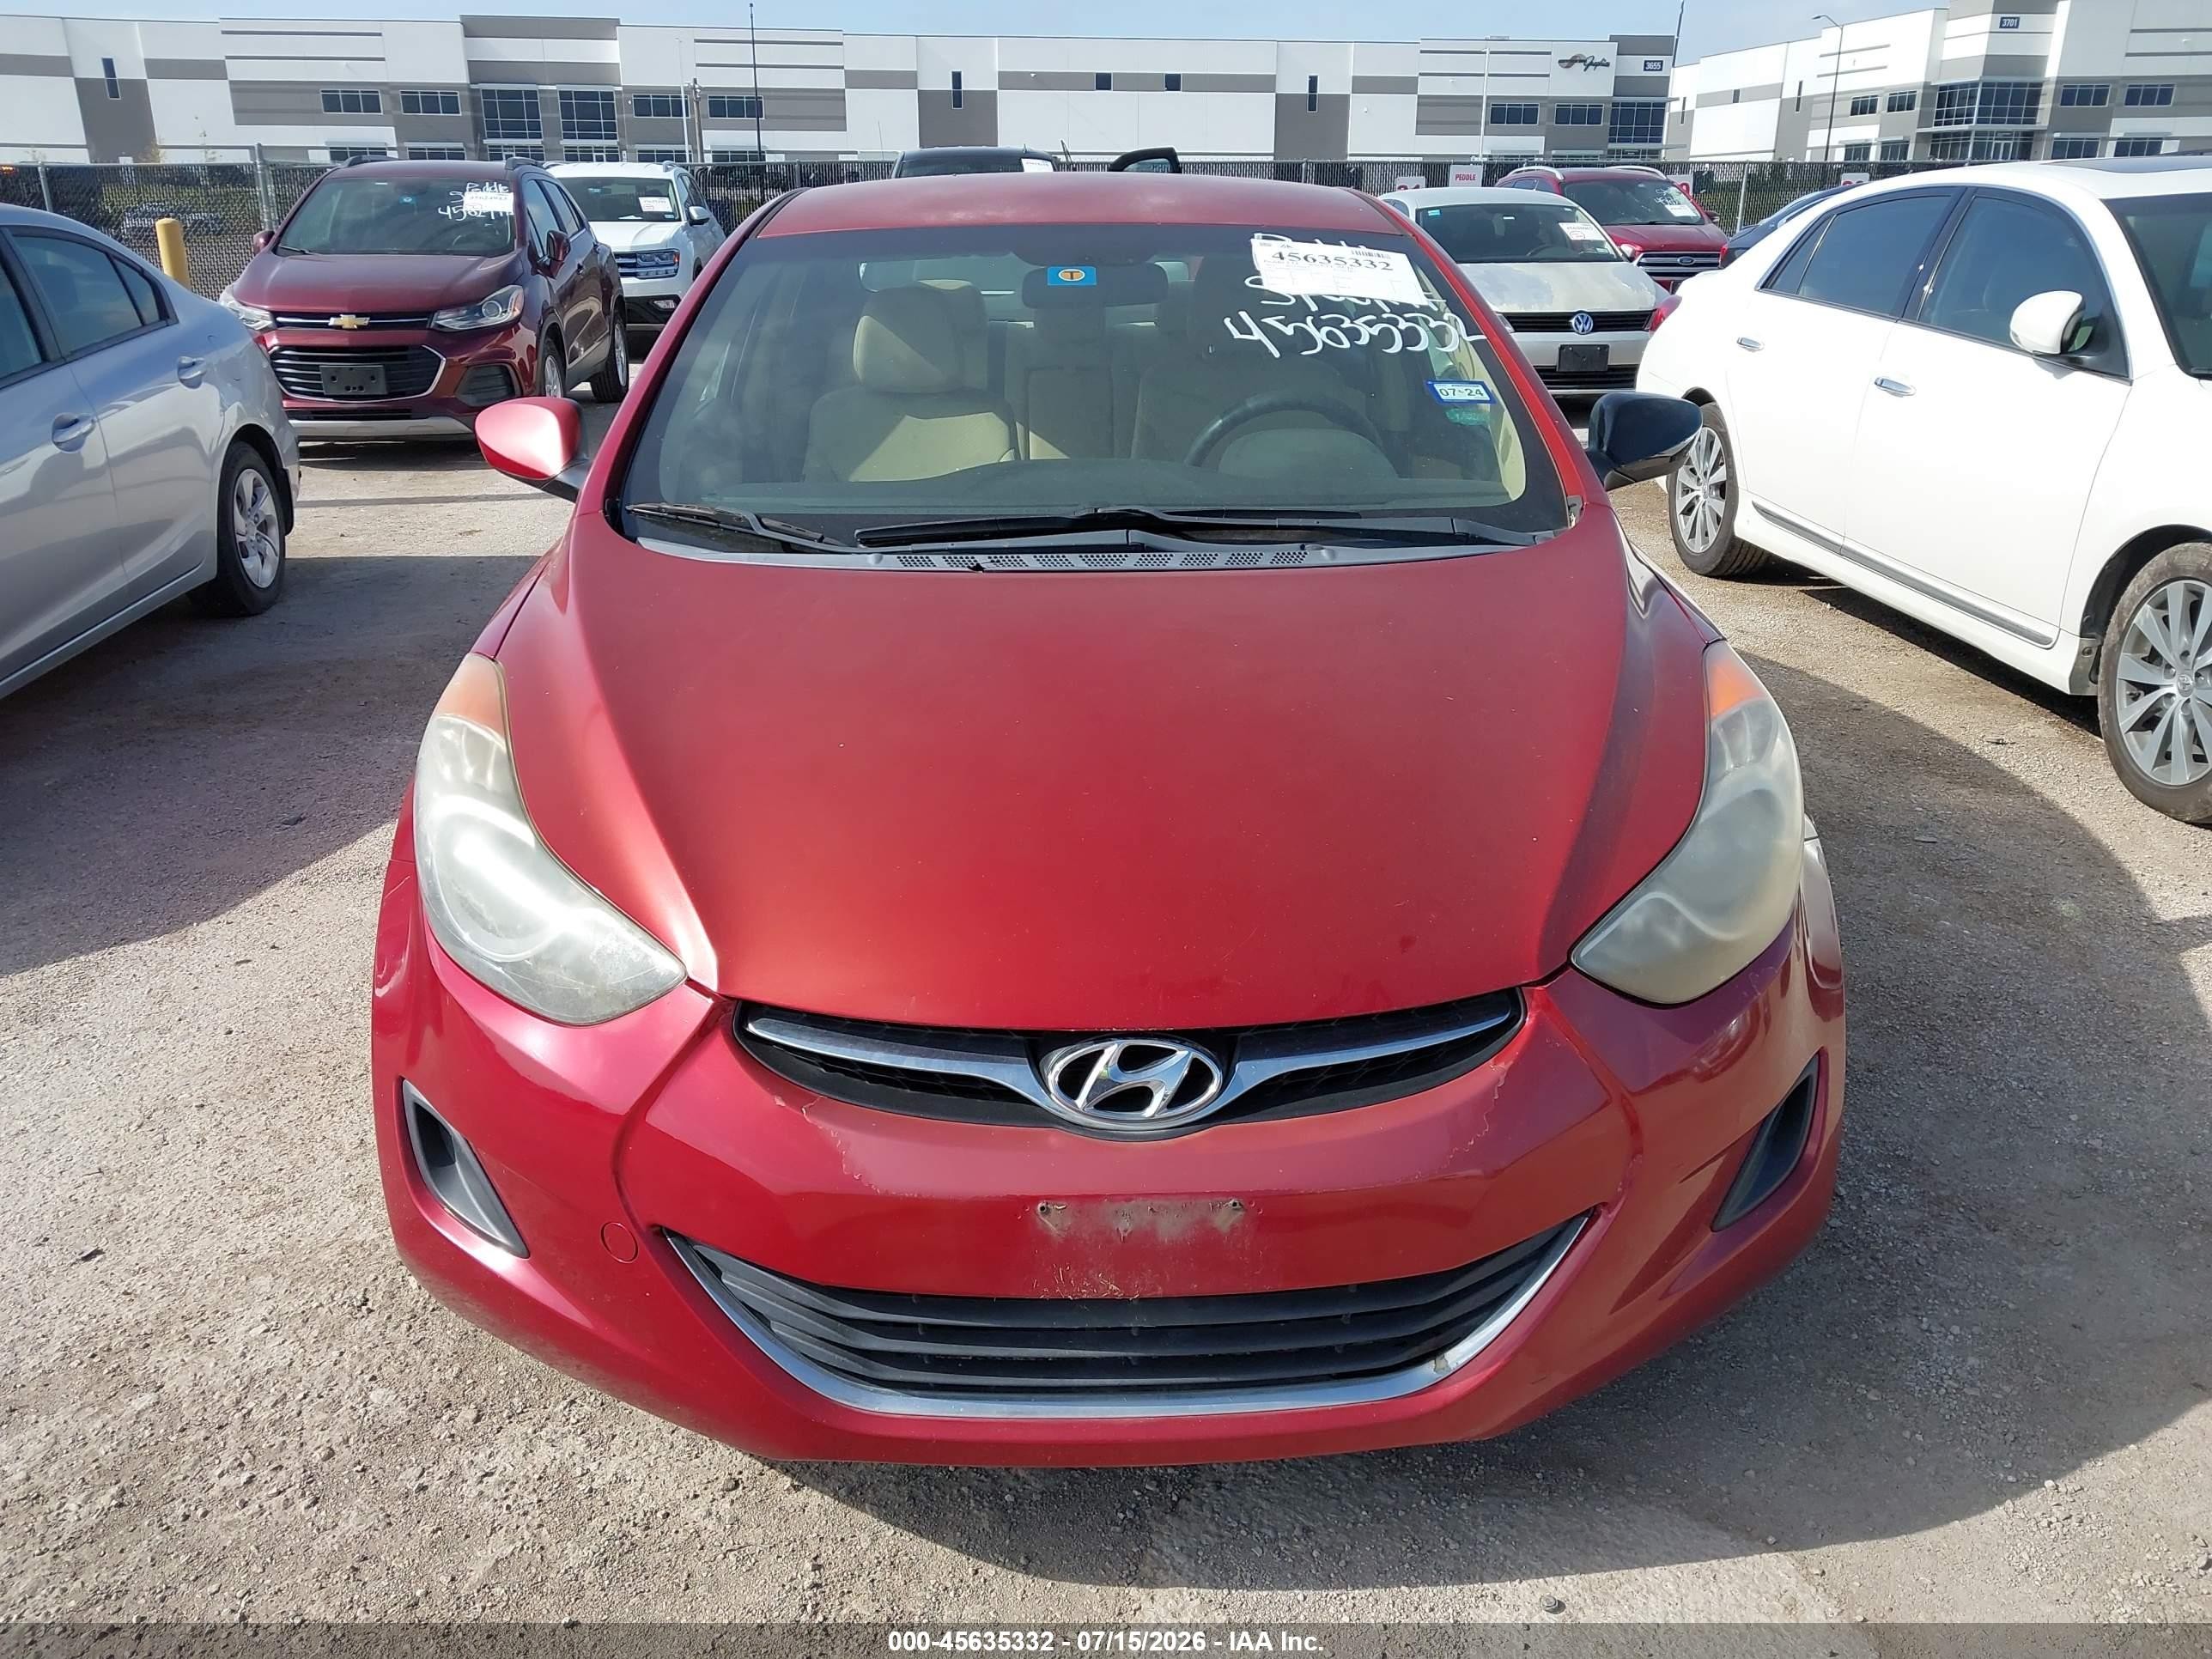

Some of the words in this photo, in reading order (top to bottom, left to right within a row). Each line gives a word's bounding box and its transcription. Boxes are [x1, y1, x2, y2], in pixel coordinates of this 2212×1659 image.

[1645, 61, 1662, 70] 3655
[1272, 251, 1394, 270] 45635332
[1223, 310, 1488, 359] 45635332
